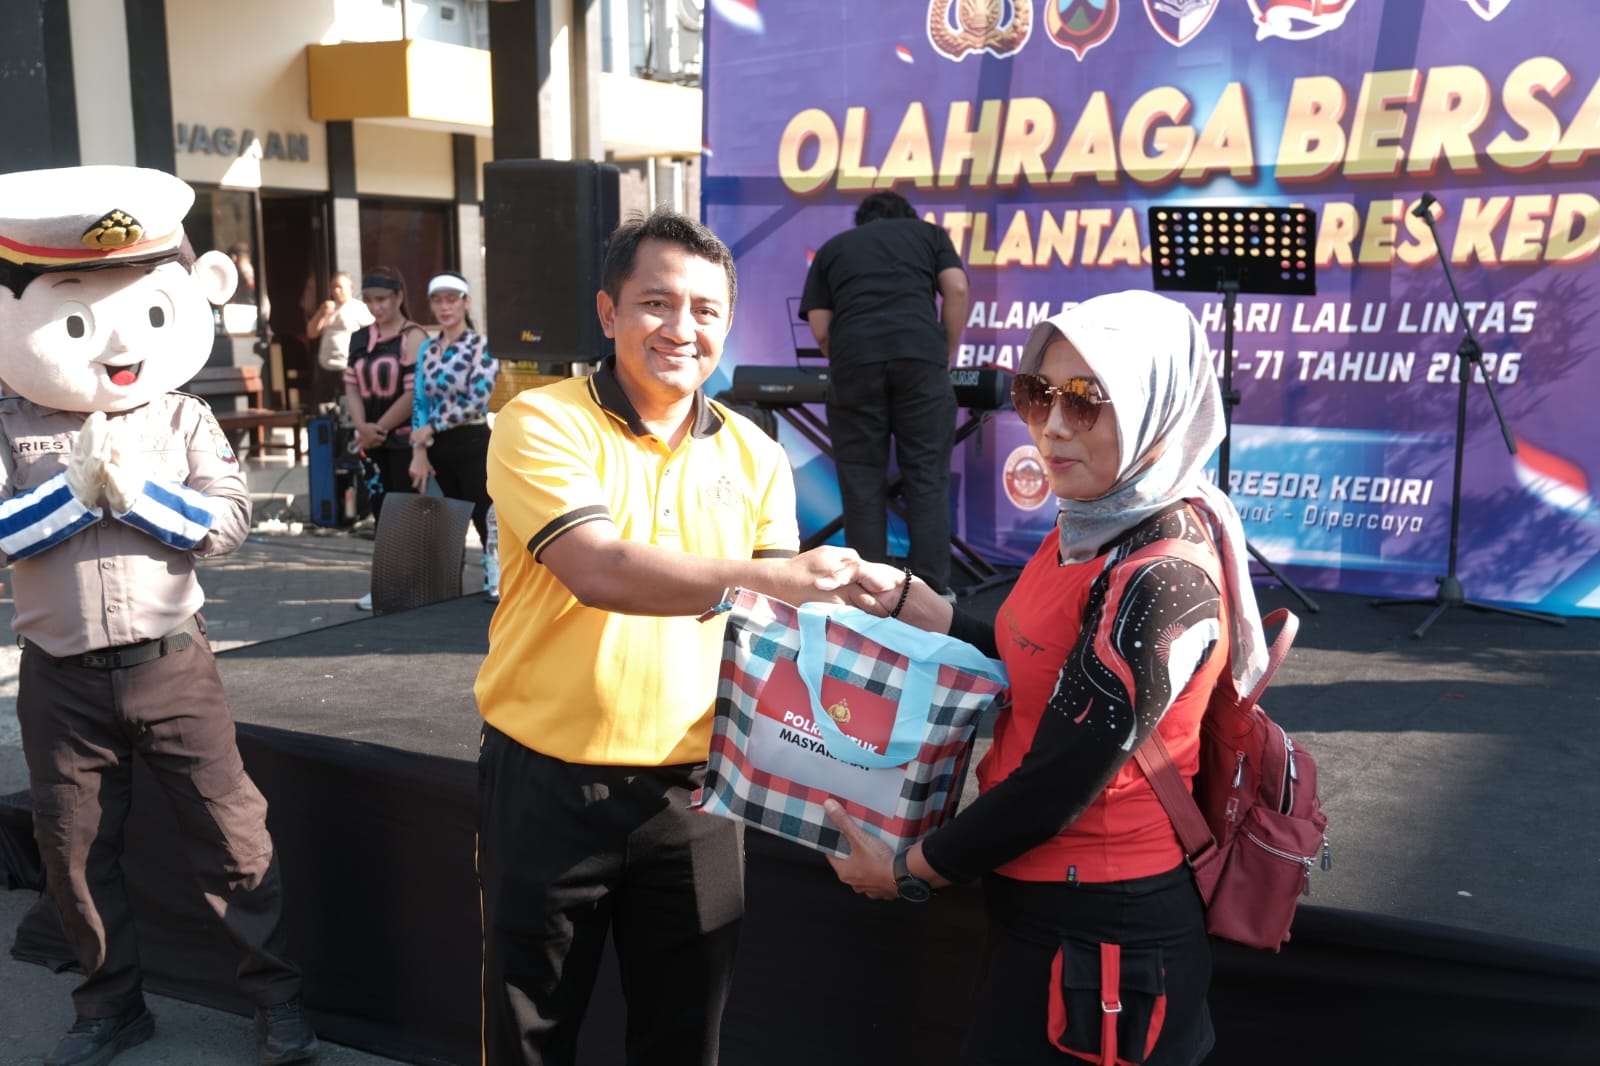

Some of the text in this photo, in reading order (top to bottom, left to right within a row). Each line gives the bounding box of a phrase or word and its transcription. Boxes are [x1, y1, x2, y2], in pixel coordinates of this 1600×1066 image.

[778, 82, 1256, 194] OLAHRAGA
[1200, 302, 1282, 332] HARI
[1291, 302, 1387, 333] LALU
[1397, 301, 1538, 333] LINTAS
[355, 356, 399, 398] 10
[1298, 351, 1416, 382] TAHUN
[1228, 469, 1321, 498] RESOR
[1330, 475, 1433, 505] KEDIRI
[1303, 504, 1424, 536] Dipercaya
